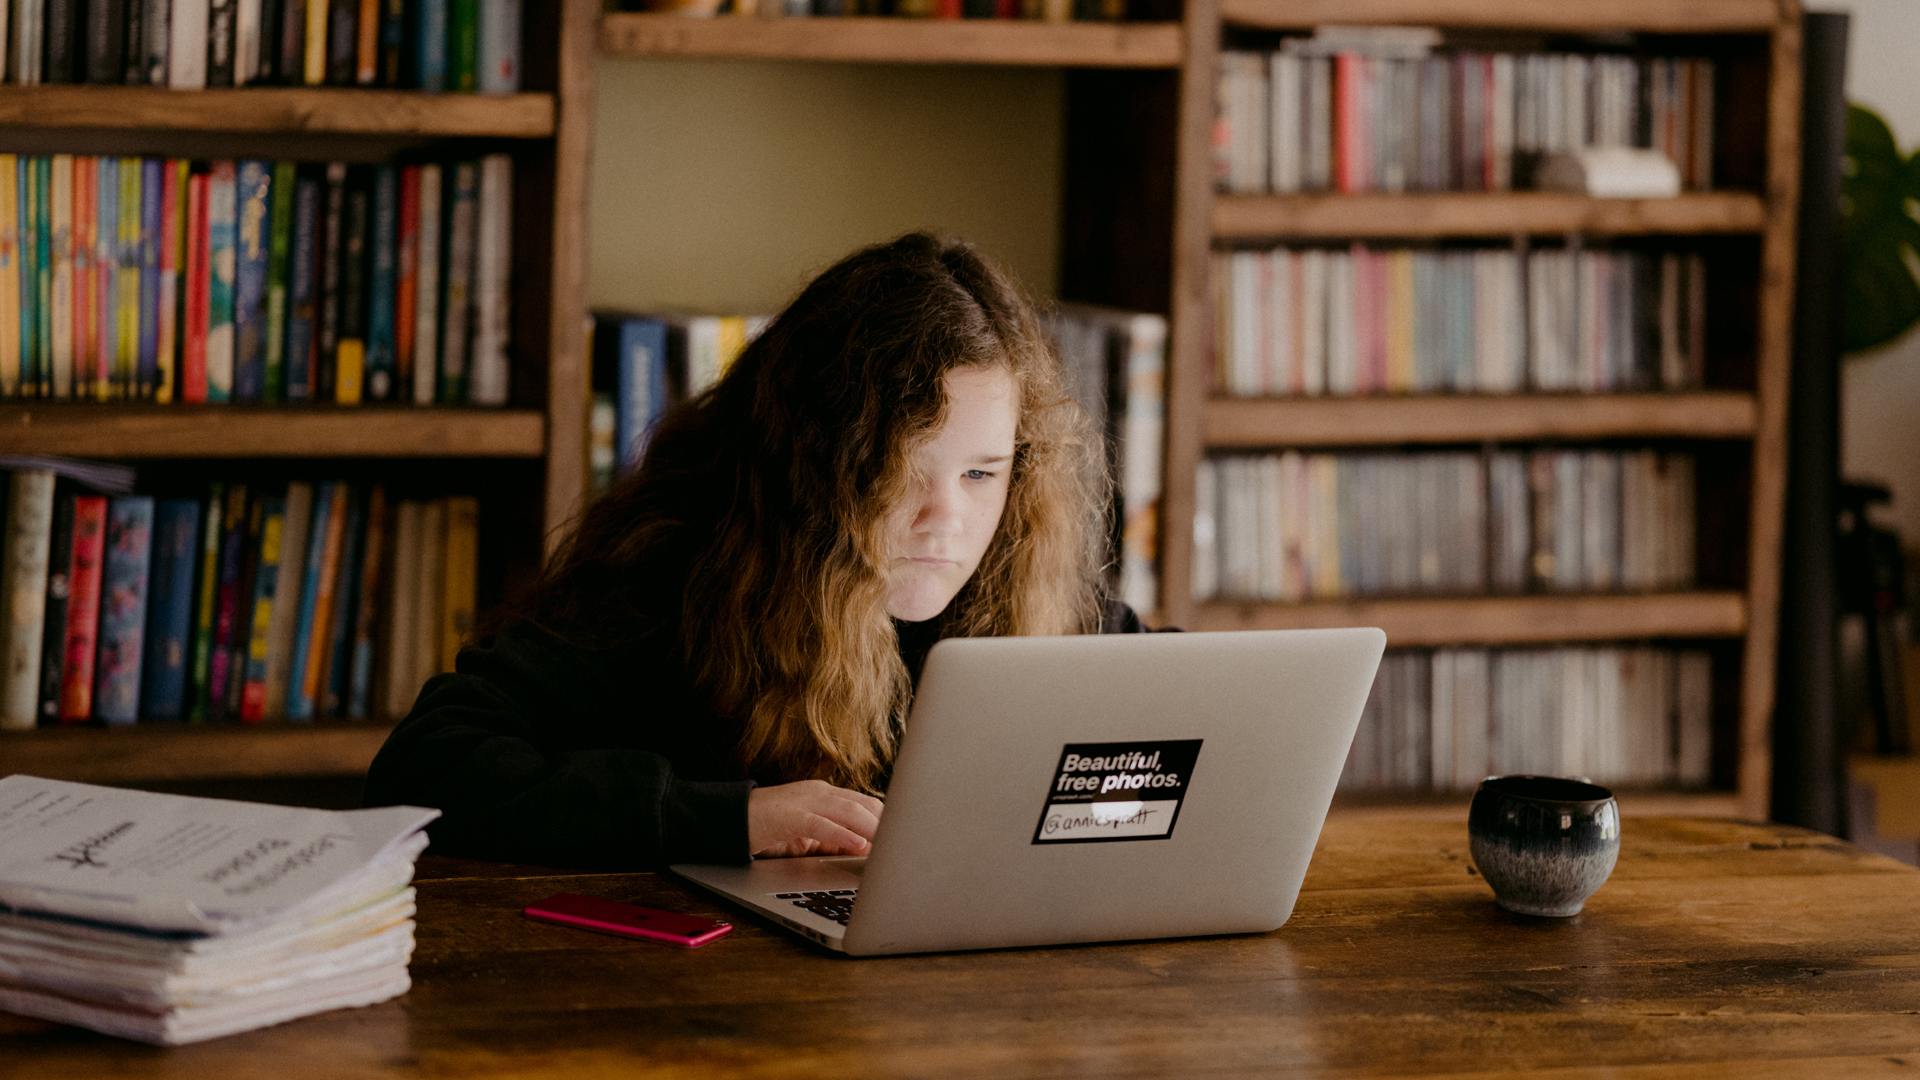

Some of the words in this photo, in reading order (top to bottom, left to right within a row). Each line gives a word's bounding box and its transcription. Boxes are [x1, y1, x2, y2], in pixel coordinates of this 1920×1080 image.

[1062, 750, 1163, 773] Beautiful,
[1056, 773, 1101, 792] free
[1100, 771, 1182, 794] photos.
